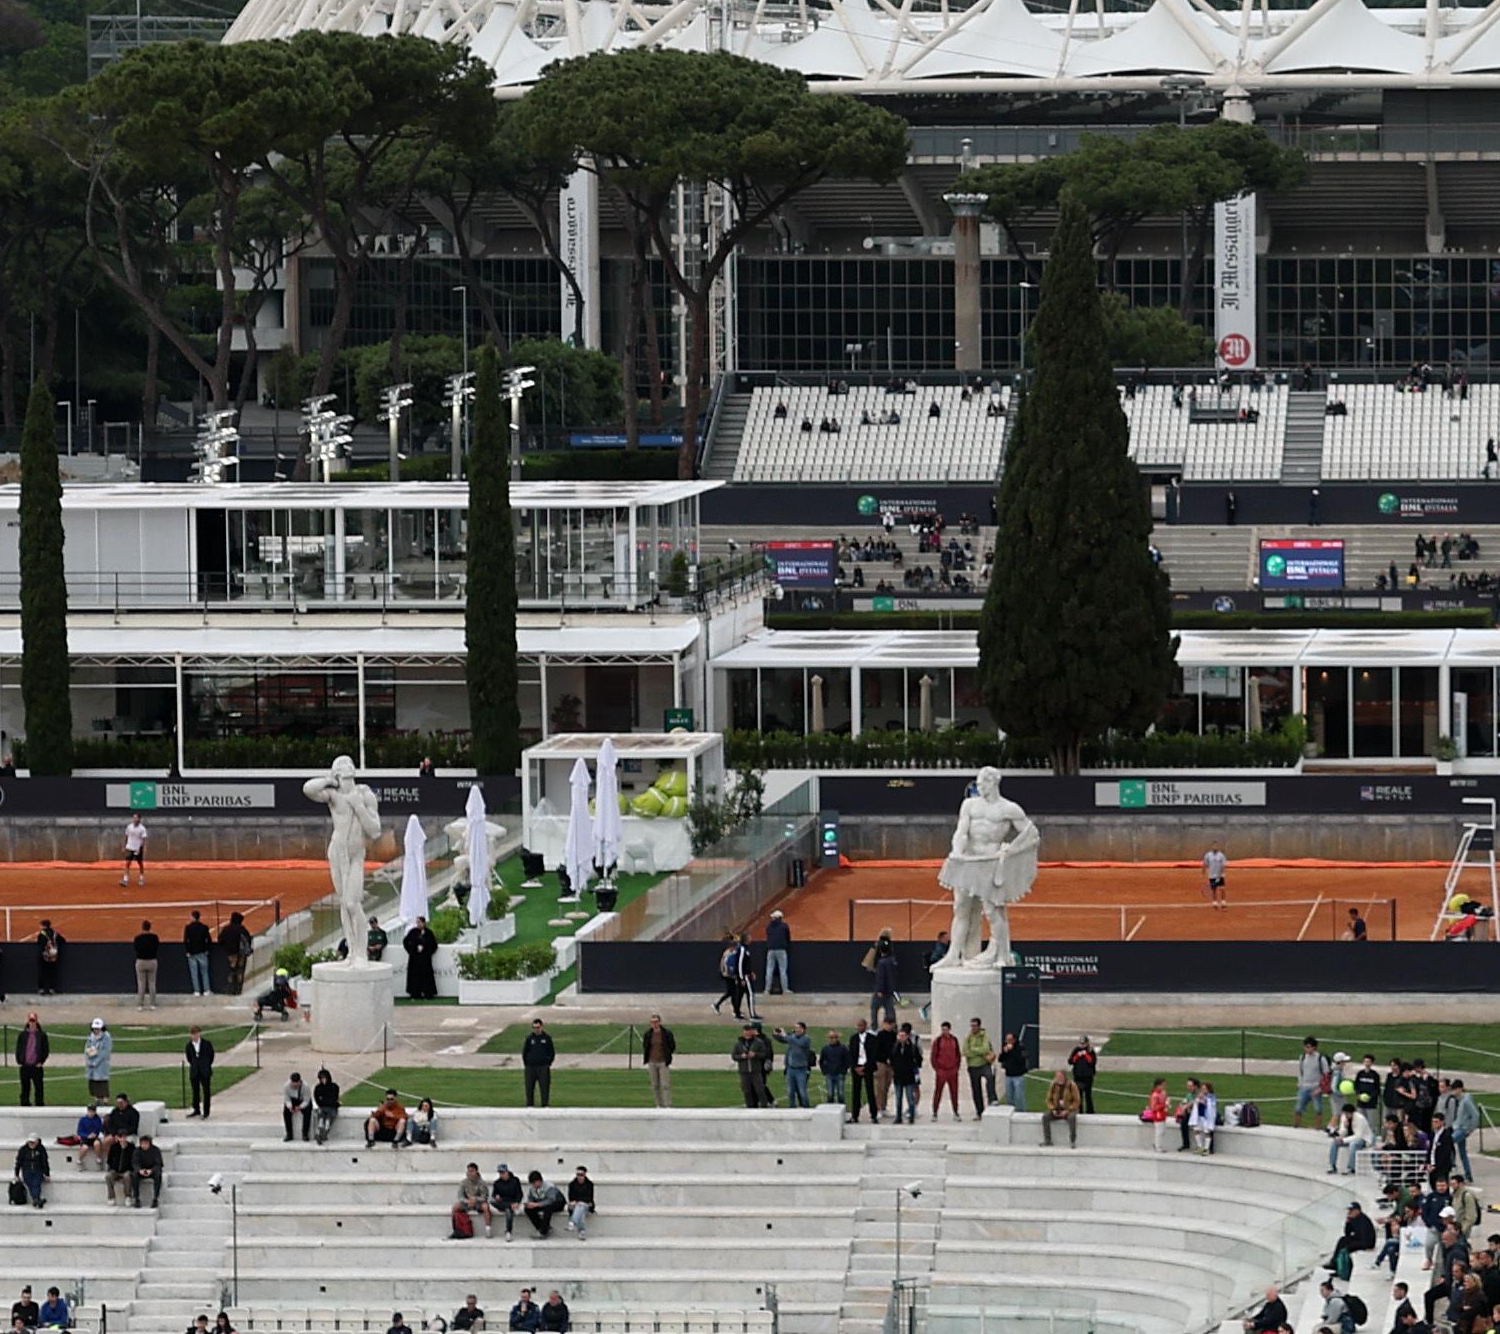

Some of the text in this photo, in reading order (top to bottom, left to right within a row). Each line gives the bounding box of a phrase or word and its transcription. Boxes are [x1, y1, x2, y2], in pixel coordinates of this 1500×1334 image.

[161, 785, 188, 795] BNL
[383, 788, 419, 797] REALE
[1151, 783, 1178, 793] BNL
[1376, 786, 1412, 796] REALE
[161, 795, 252, 806] BNP PARIBAS
[1151, 794, 1242, 804] BNP PARIBAS
[1024, 955, 1099, 964] INTERNAZIONALI
[1056, 963, 1099, 972] D'ITALIA
